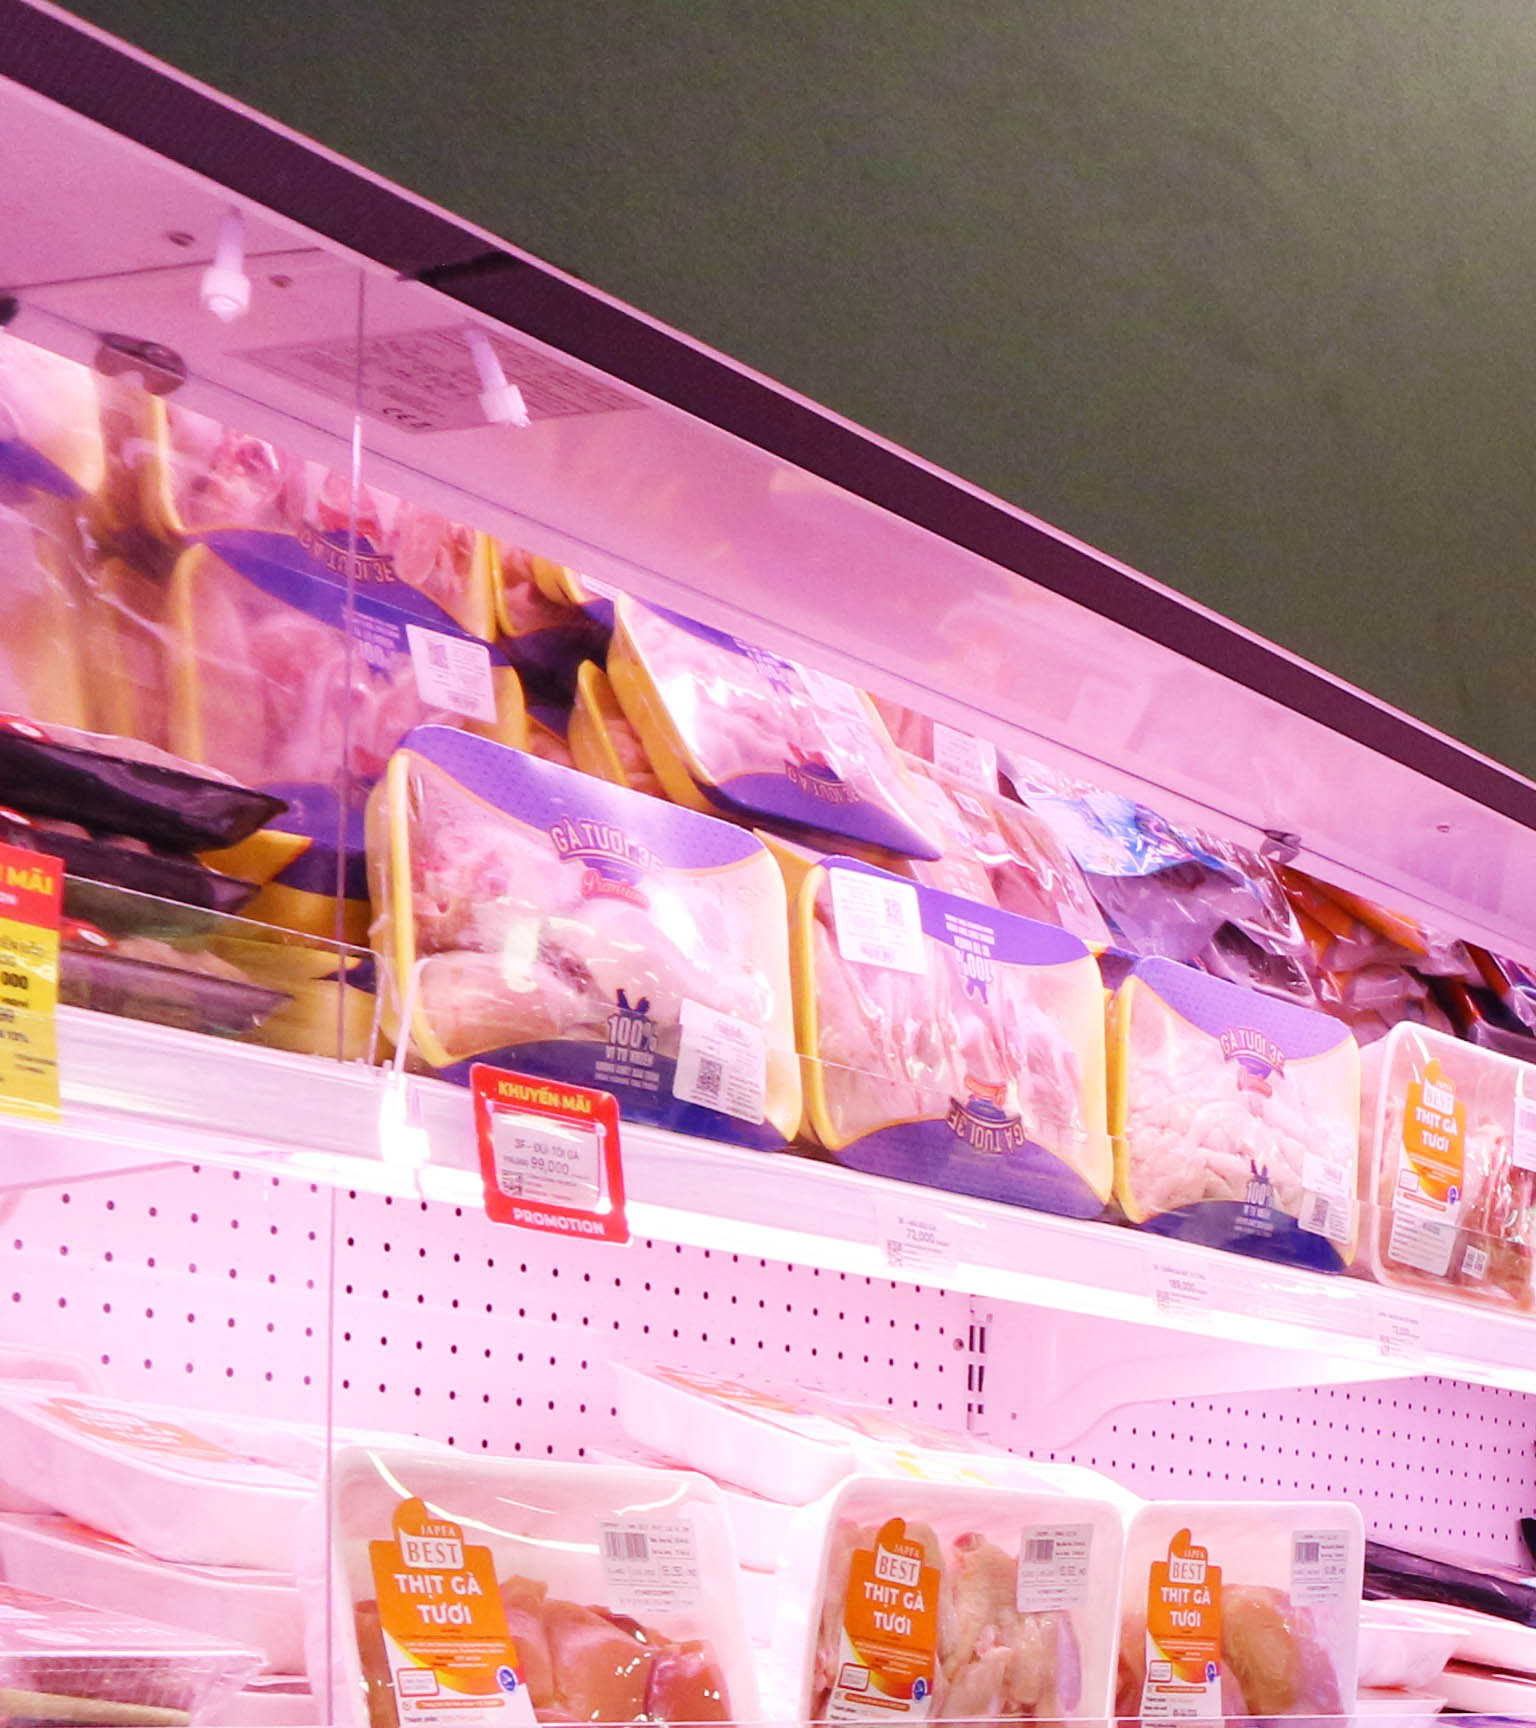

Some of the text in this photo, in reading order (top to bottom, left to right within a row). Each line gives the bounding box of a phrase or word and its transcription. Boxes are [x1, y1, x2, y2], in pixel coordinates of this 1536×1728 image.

[498, 1080, 592, 1114] KHUYẾN MÃI
[512, 1207, 606, 1236] PROMOTION
[406, 1540, 459, 1565] BEST
[878, 1554, 919, 1583] BEST
[1172, 1560, 1205, 1582] BEST
[393, 1571, 484, 1600] THỊT GÀ
[863, 1580, 927, 1613] THỊT GÀ
[1159, 1584, 1213, 1608] THỊT GÀ
[415, 1601, 474, 1625] TƯƠI
[872, 1610, 913, 1637] TƯƠI
[1169, 1609, 1202, 1628] TƯƠI
